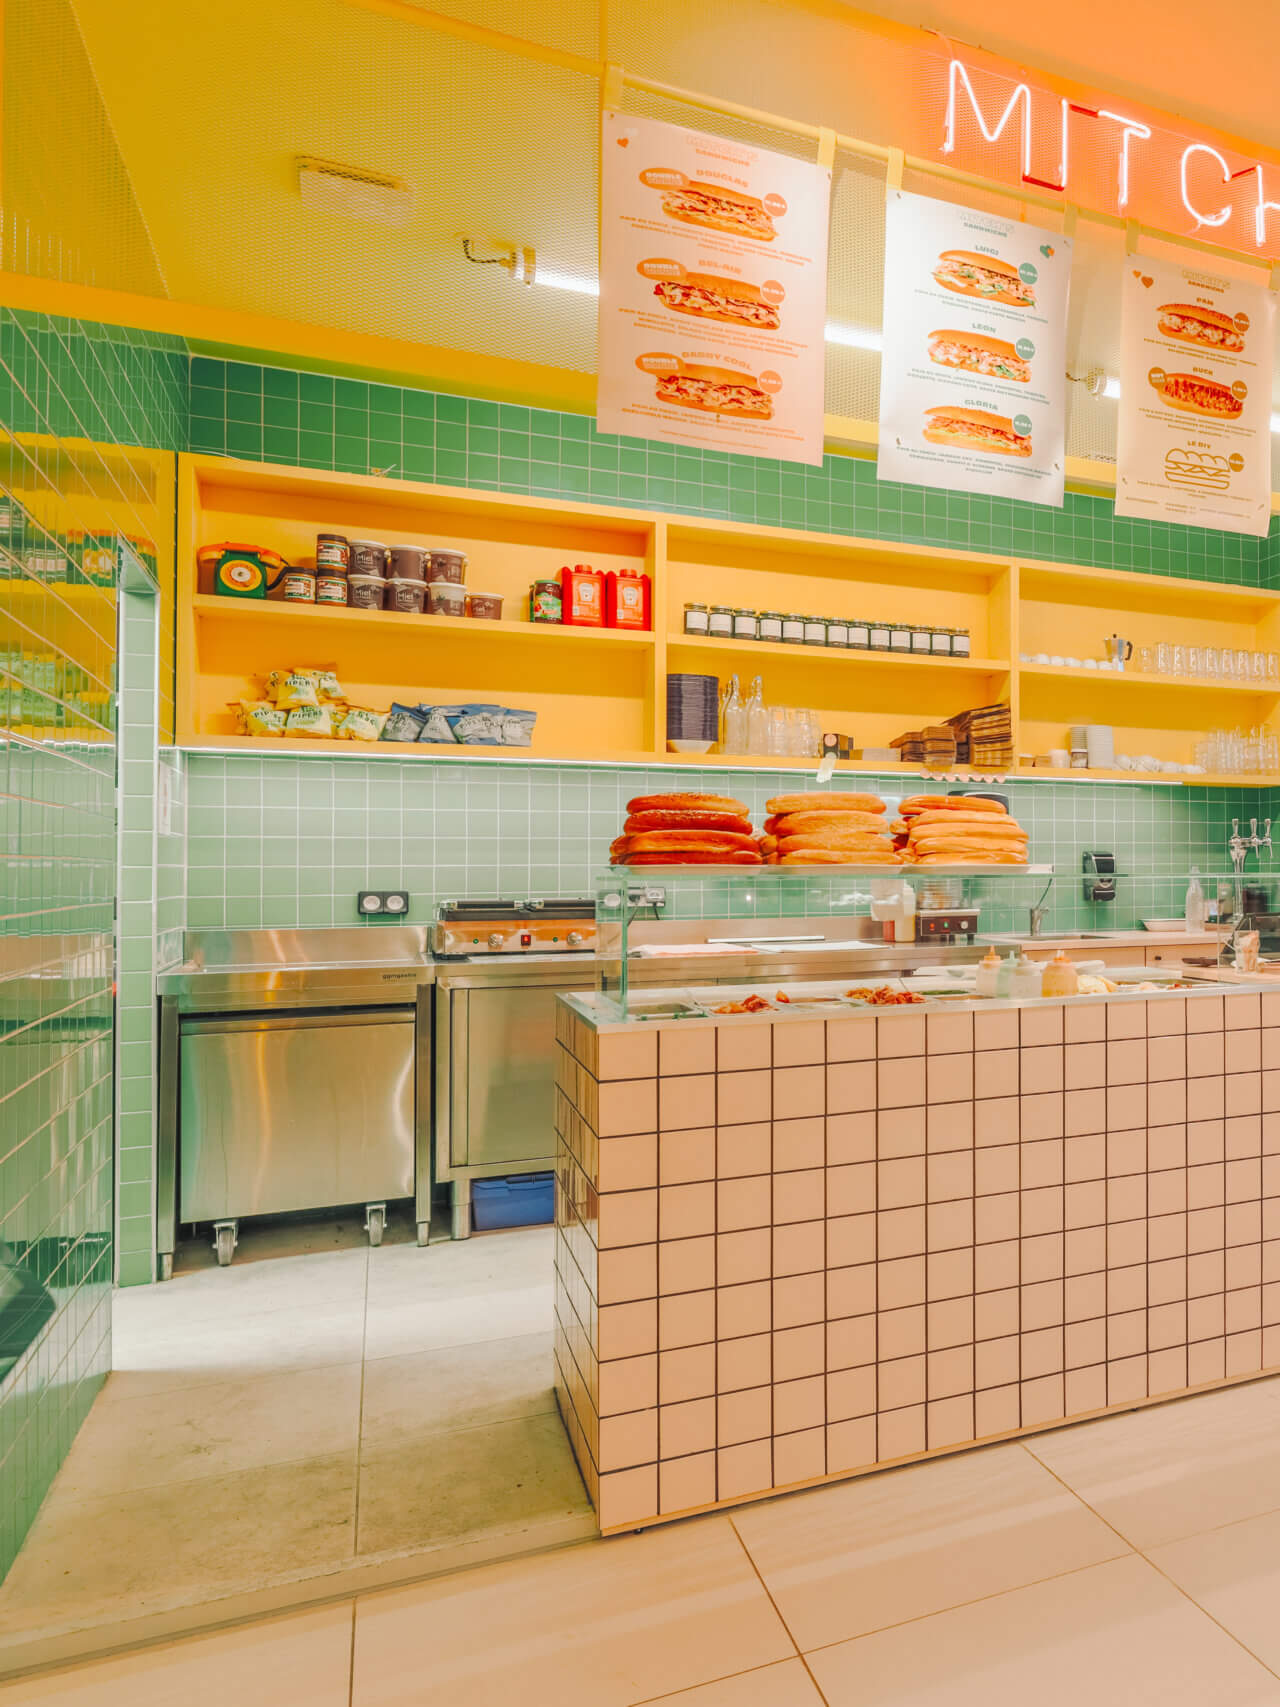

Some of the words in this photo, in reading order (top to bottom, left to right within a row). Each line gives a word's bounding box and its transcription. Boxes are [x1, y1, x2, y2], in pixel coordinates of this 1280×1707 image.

[975, 245, 1000, 257] LUIGI
[972, 323, 997, 334] LEON
[964, 399, 999, 411] GLORIA
[357, 552, 373, 562] Miel
[355, 588, 371, 597] Miel
[397, 592, 414, 602] Miel
